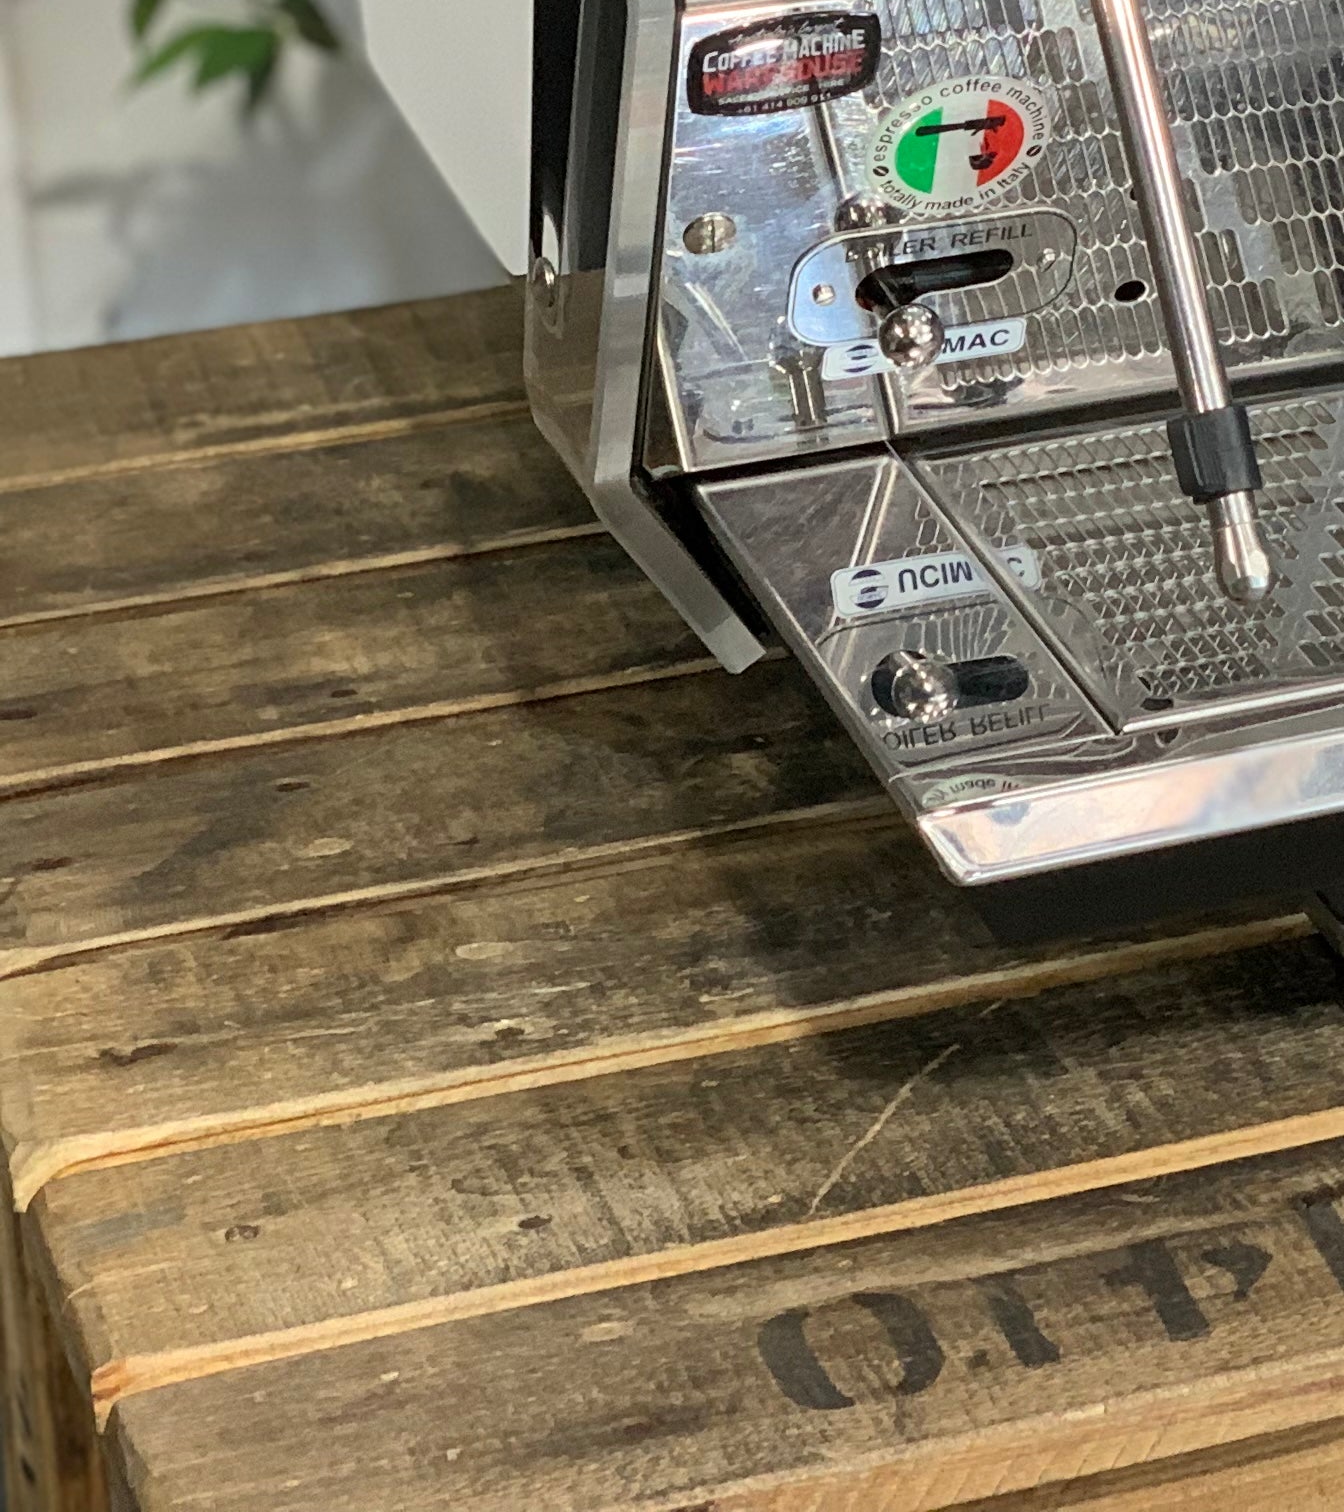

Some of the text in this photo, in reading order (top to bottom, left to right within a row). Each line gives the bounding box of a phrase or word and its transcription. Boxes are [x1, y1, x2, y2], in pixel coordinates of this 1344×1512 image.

[783, 29, 866, 61] MACHINE
[939, 78, 1003, 98] coffee
[1006, 88, 1046, 141] machine
[880, 161, 1031, 211] totally made in Italy
[950, 224, 1033, 248] REFILL
[943, 329, 1011, 355] MAC
